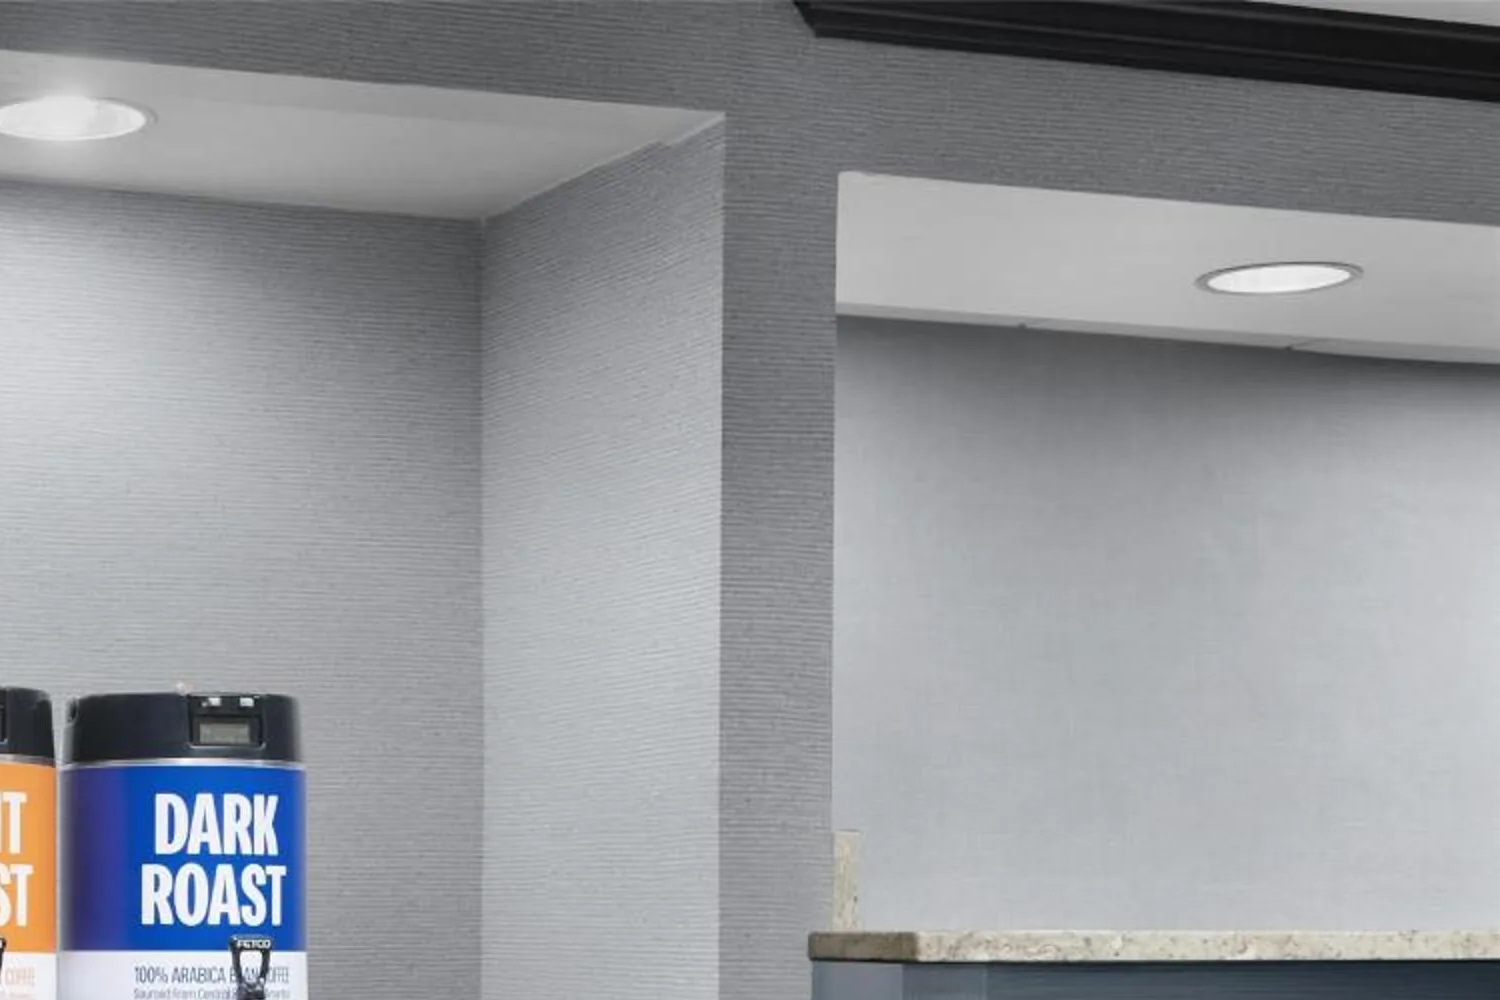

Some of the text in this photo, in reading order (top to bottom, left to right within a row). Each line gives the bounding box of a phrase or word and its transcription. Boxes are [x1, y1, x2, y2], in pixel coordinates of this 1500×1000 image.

[154, 793, 278, 855] DARK
[141, 864, 287, 927] ROAST
[237, 939, 271, 949] FETCO
[134, 966, 168, 984] 100%
[171, 966, 227, 984] ARABICA
